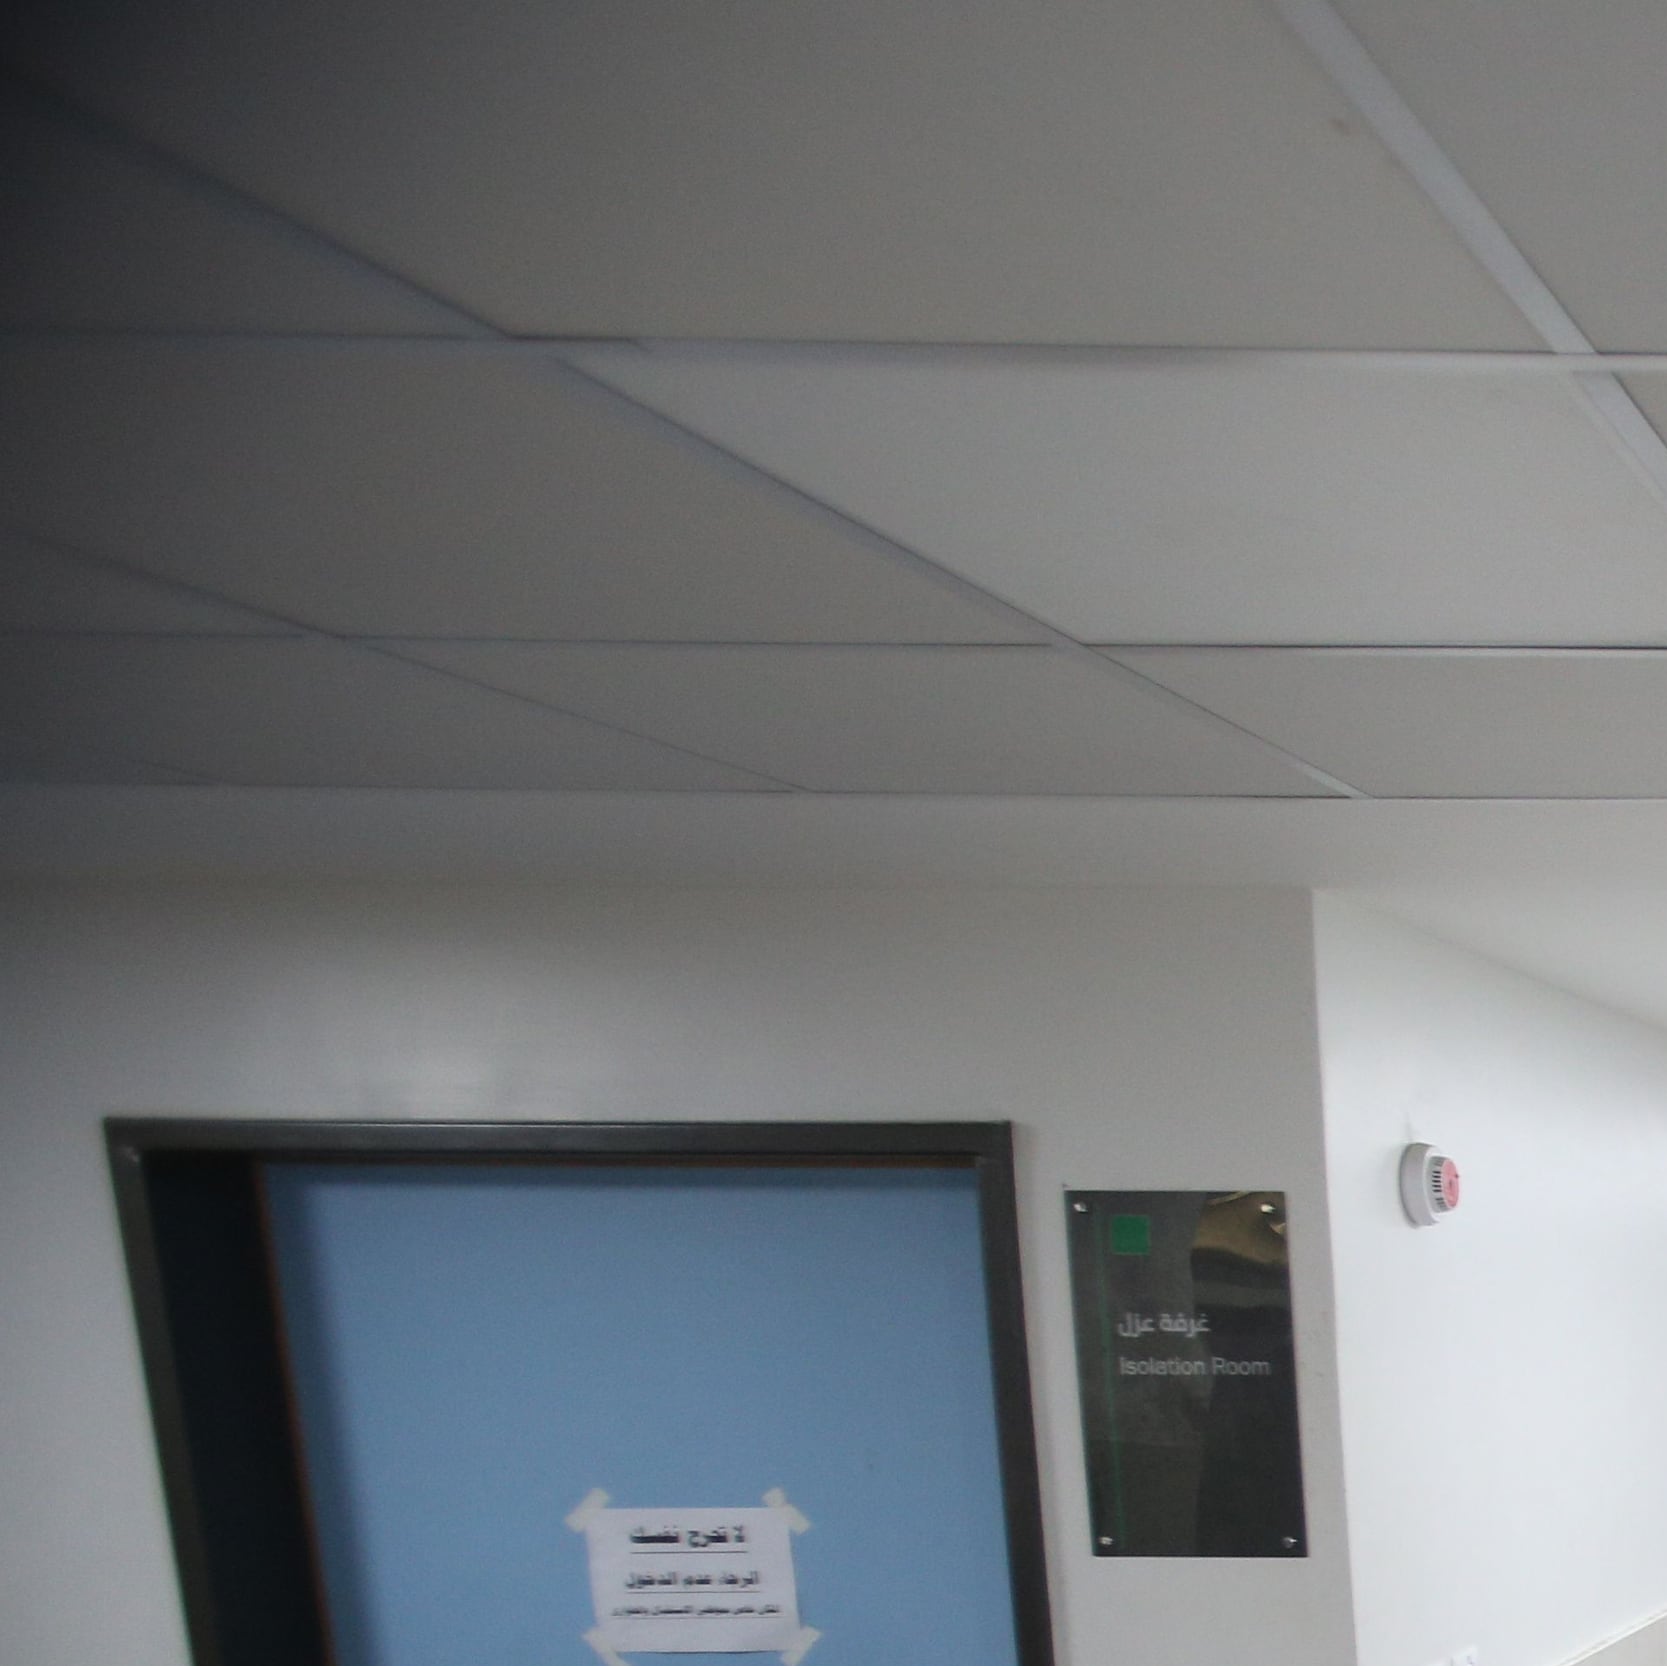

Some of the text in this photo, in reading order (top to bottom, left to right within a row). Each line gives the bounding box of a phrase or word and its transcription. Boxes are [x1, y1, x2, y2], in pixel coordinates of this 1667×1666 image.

[1118, 1313, 1211, 1338] غرفة عزل
[1120, 1356, 1271, 1375] Isolation Room
